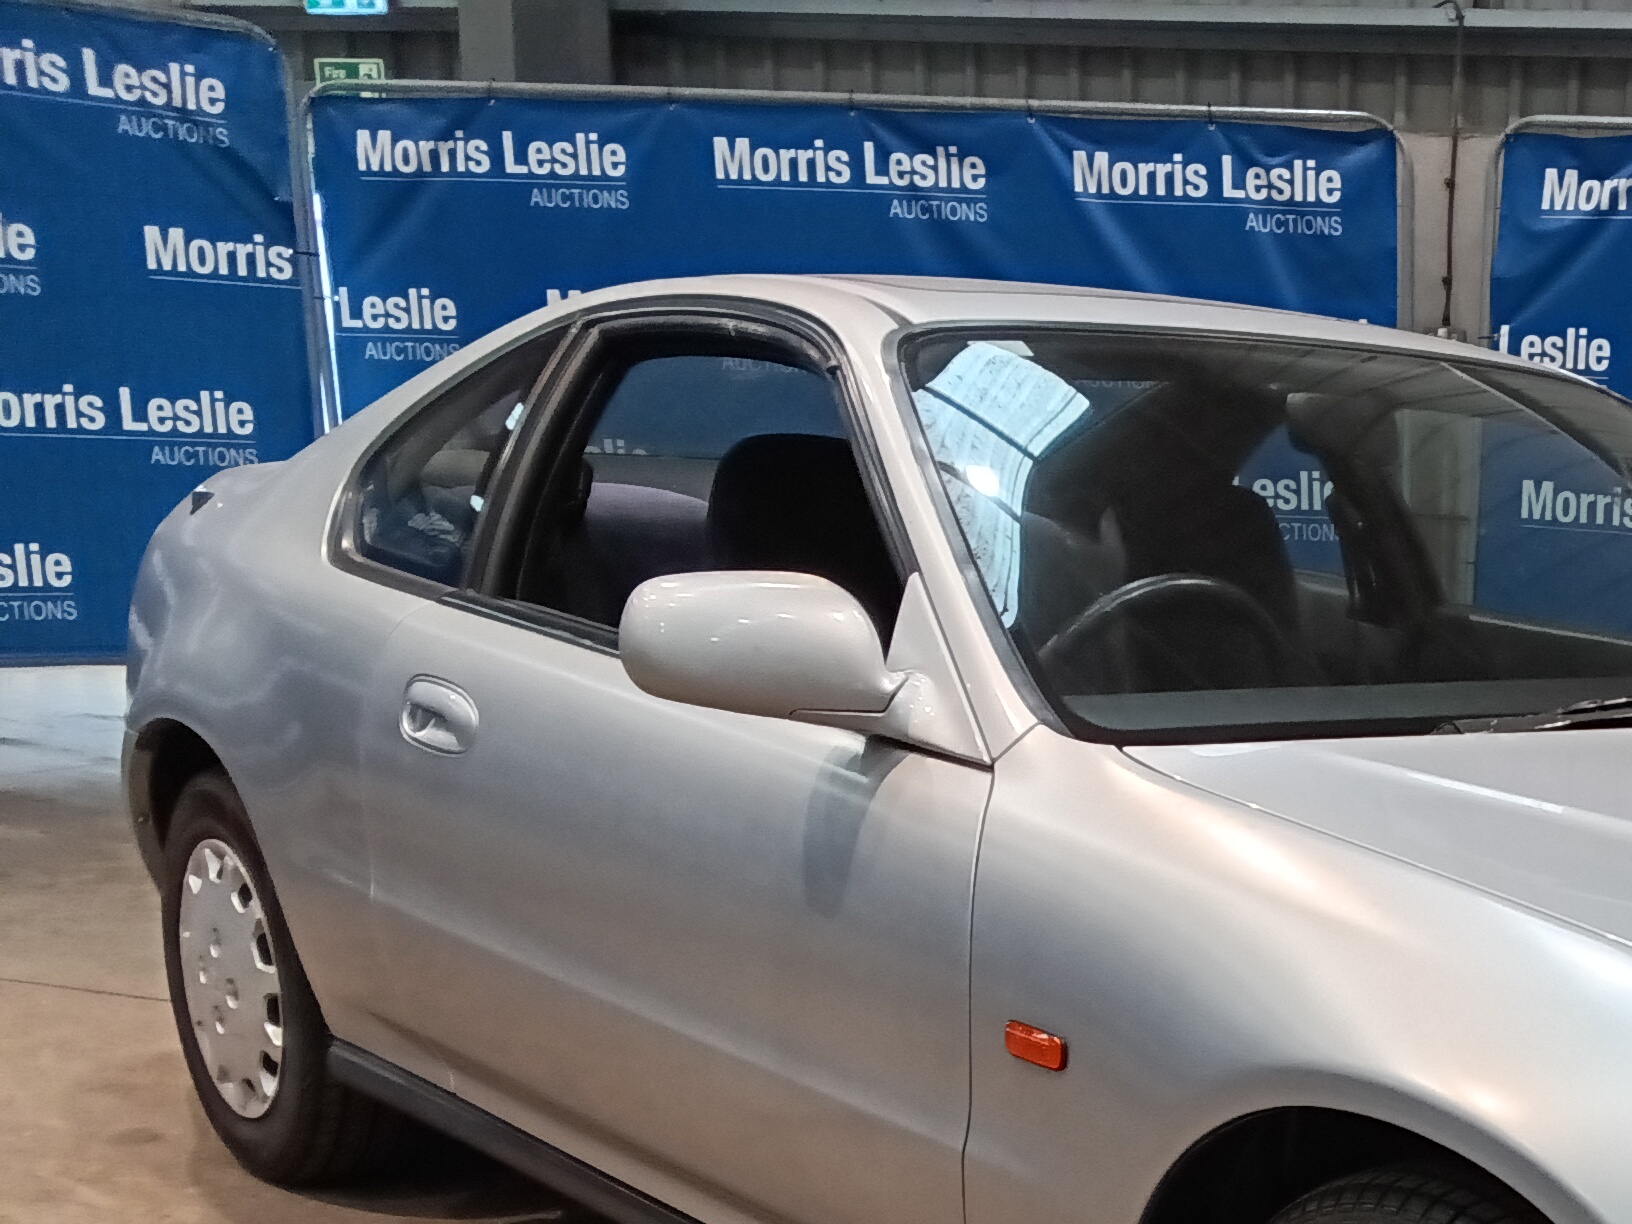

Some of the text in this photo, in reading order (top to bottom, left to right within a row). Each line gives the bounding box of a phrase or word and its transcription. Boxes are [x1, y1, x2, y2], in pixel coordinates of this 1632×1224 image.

[0, 39, 225, 114] ris Leslie
[117, 114, 229, 147] AUCTIONS
[357, 129, 626, 176] Morris Leslie
[713, 137, 985, 189] Morris Leslie
[1073, 151, 1341, 203] Morris Leslie
[531, 188, 629, 209] AUCTIONS
[890, 199, 987, 222] AUCTIONS
[1246, 212, 1342, 235] AUCTIONS
[144, 225, 293, 280] Morris
[337, 287, 456, 330] Leslie
[119, 387, 254, 435] Leslie
[151, 446, 258, 466] AUCTIONS
[1233, 471, 1333, 510] esli
[1279, 522, 1339, 541] CTION
